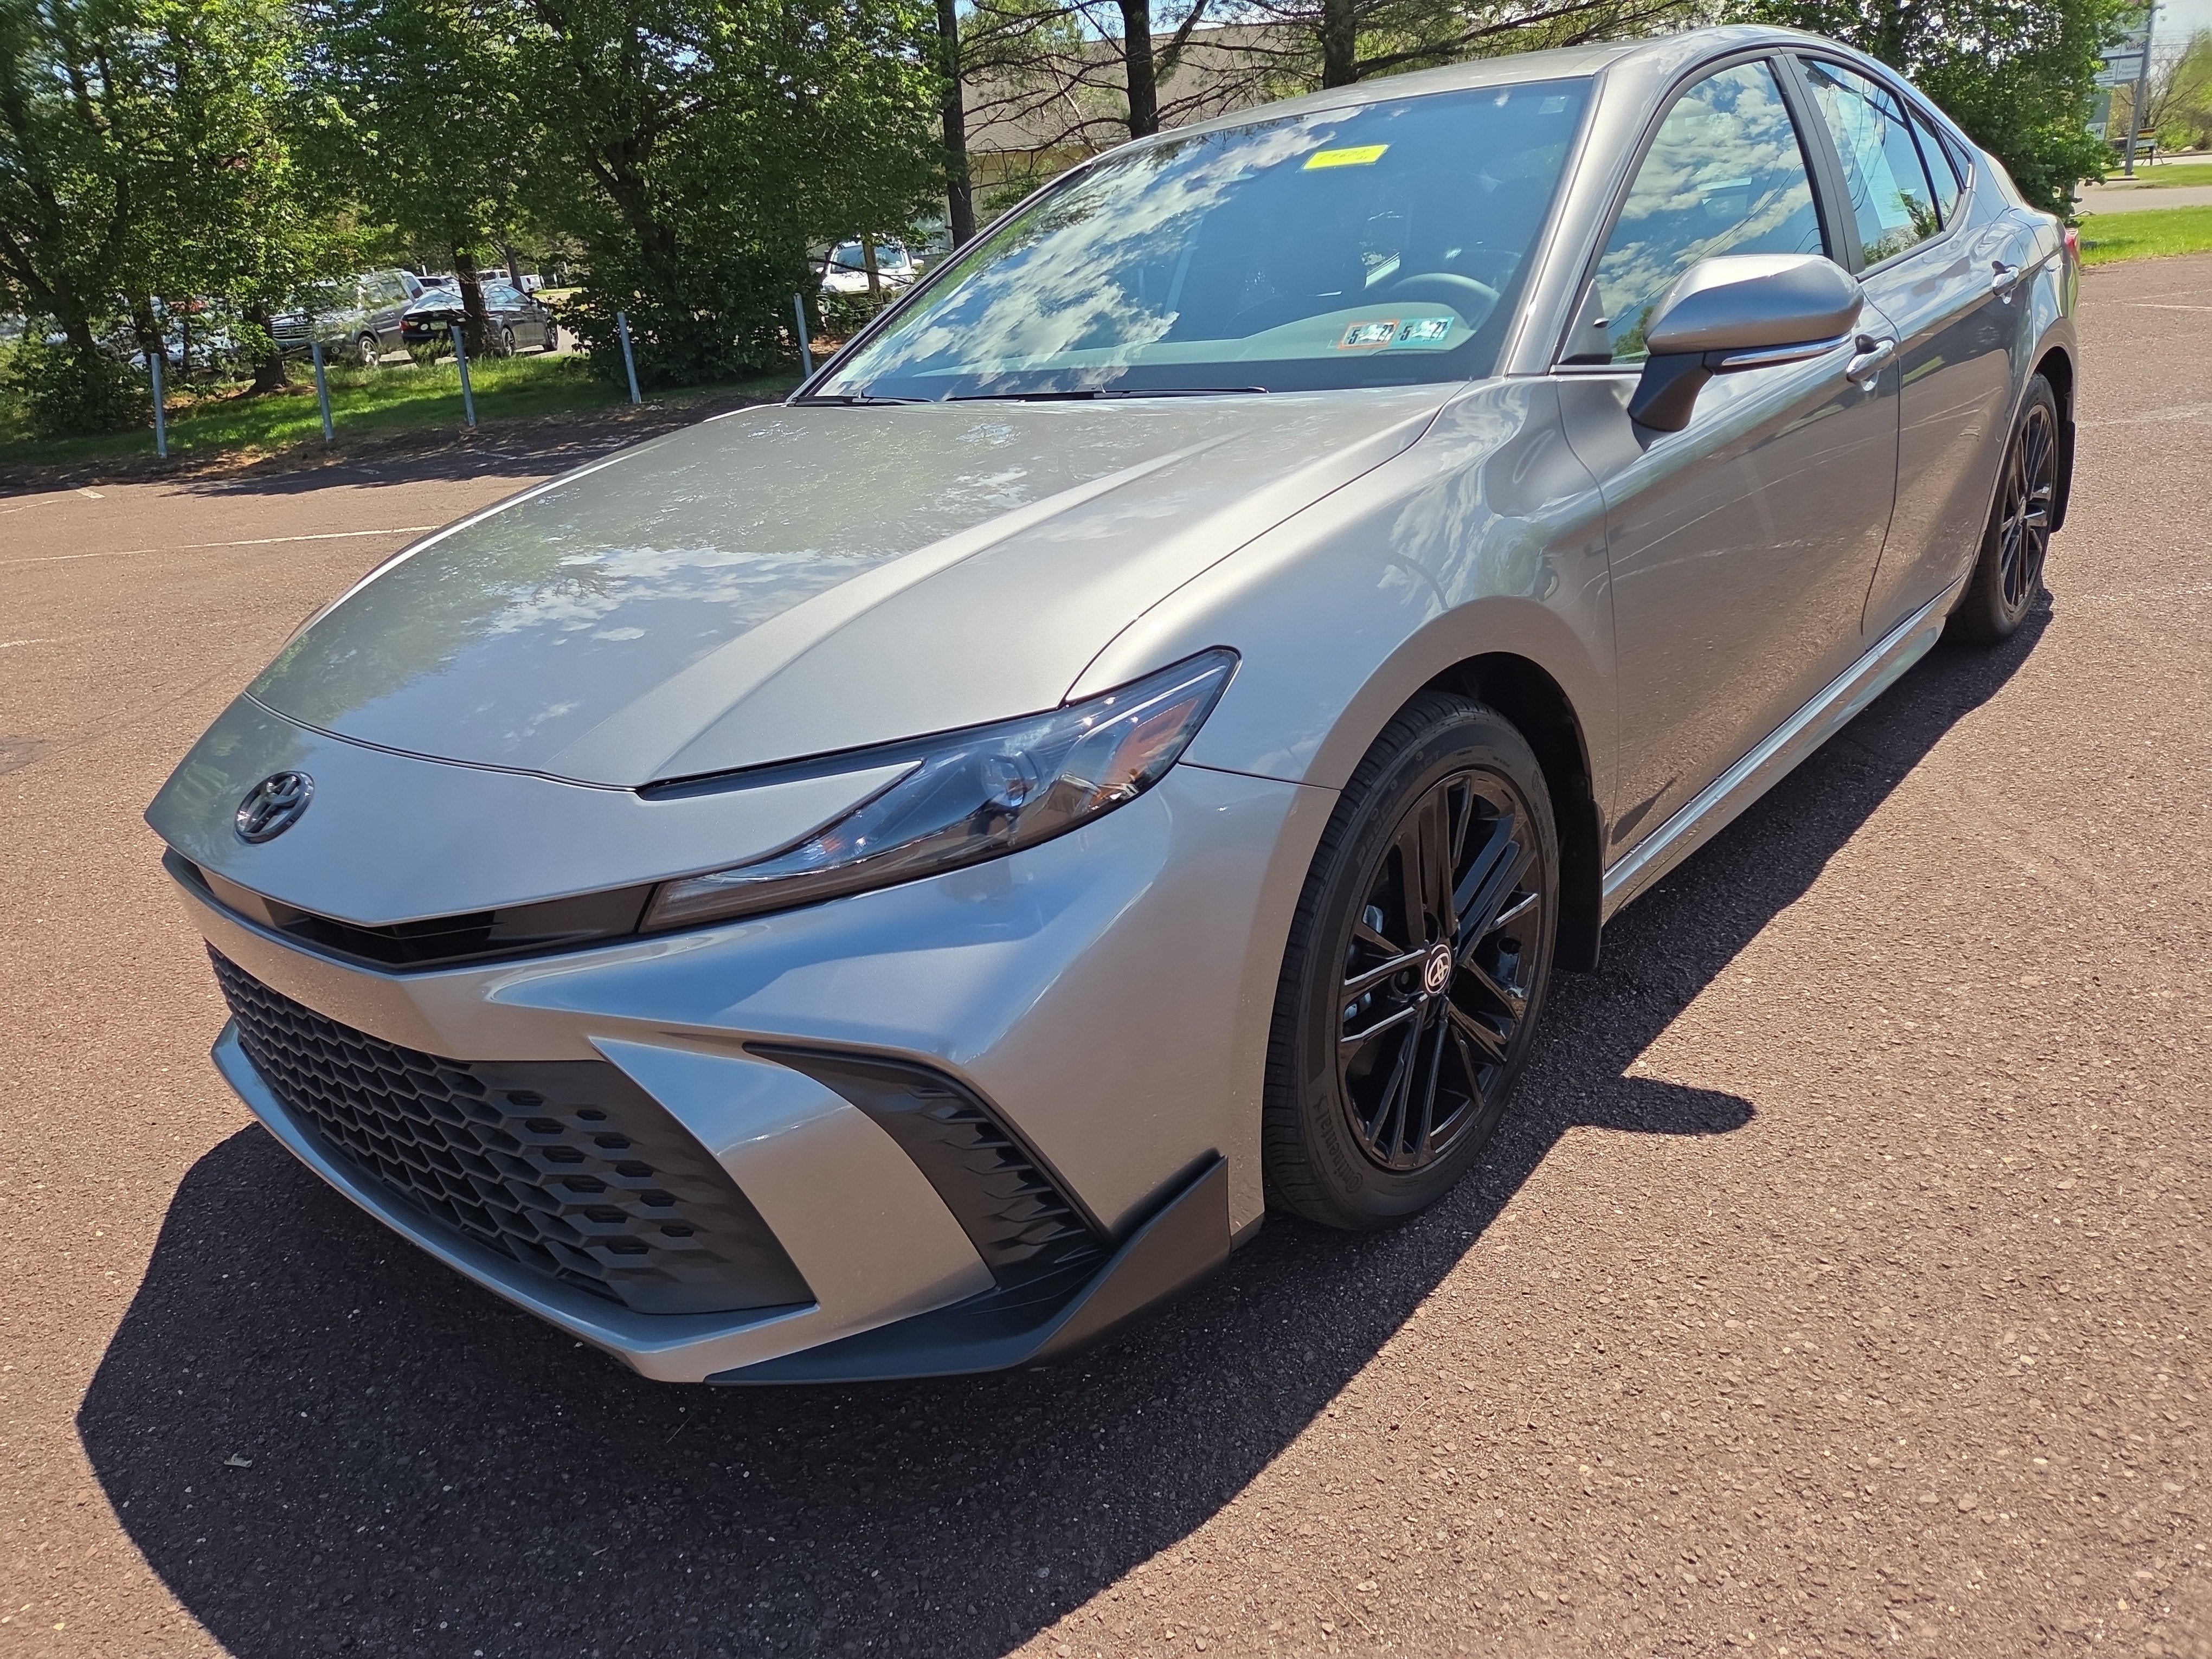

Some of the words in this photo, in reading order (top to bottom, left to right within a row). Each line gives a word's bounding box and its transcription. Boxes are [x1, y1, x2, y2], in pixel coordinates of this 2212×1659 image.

[1348, 330, 1360, 345] 5
[1399, 325, 1413, 341] 5
[1315, 1110, 1363, 1194] Continental
